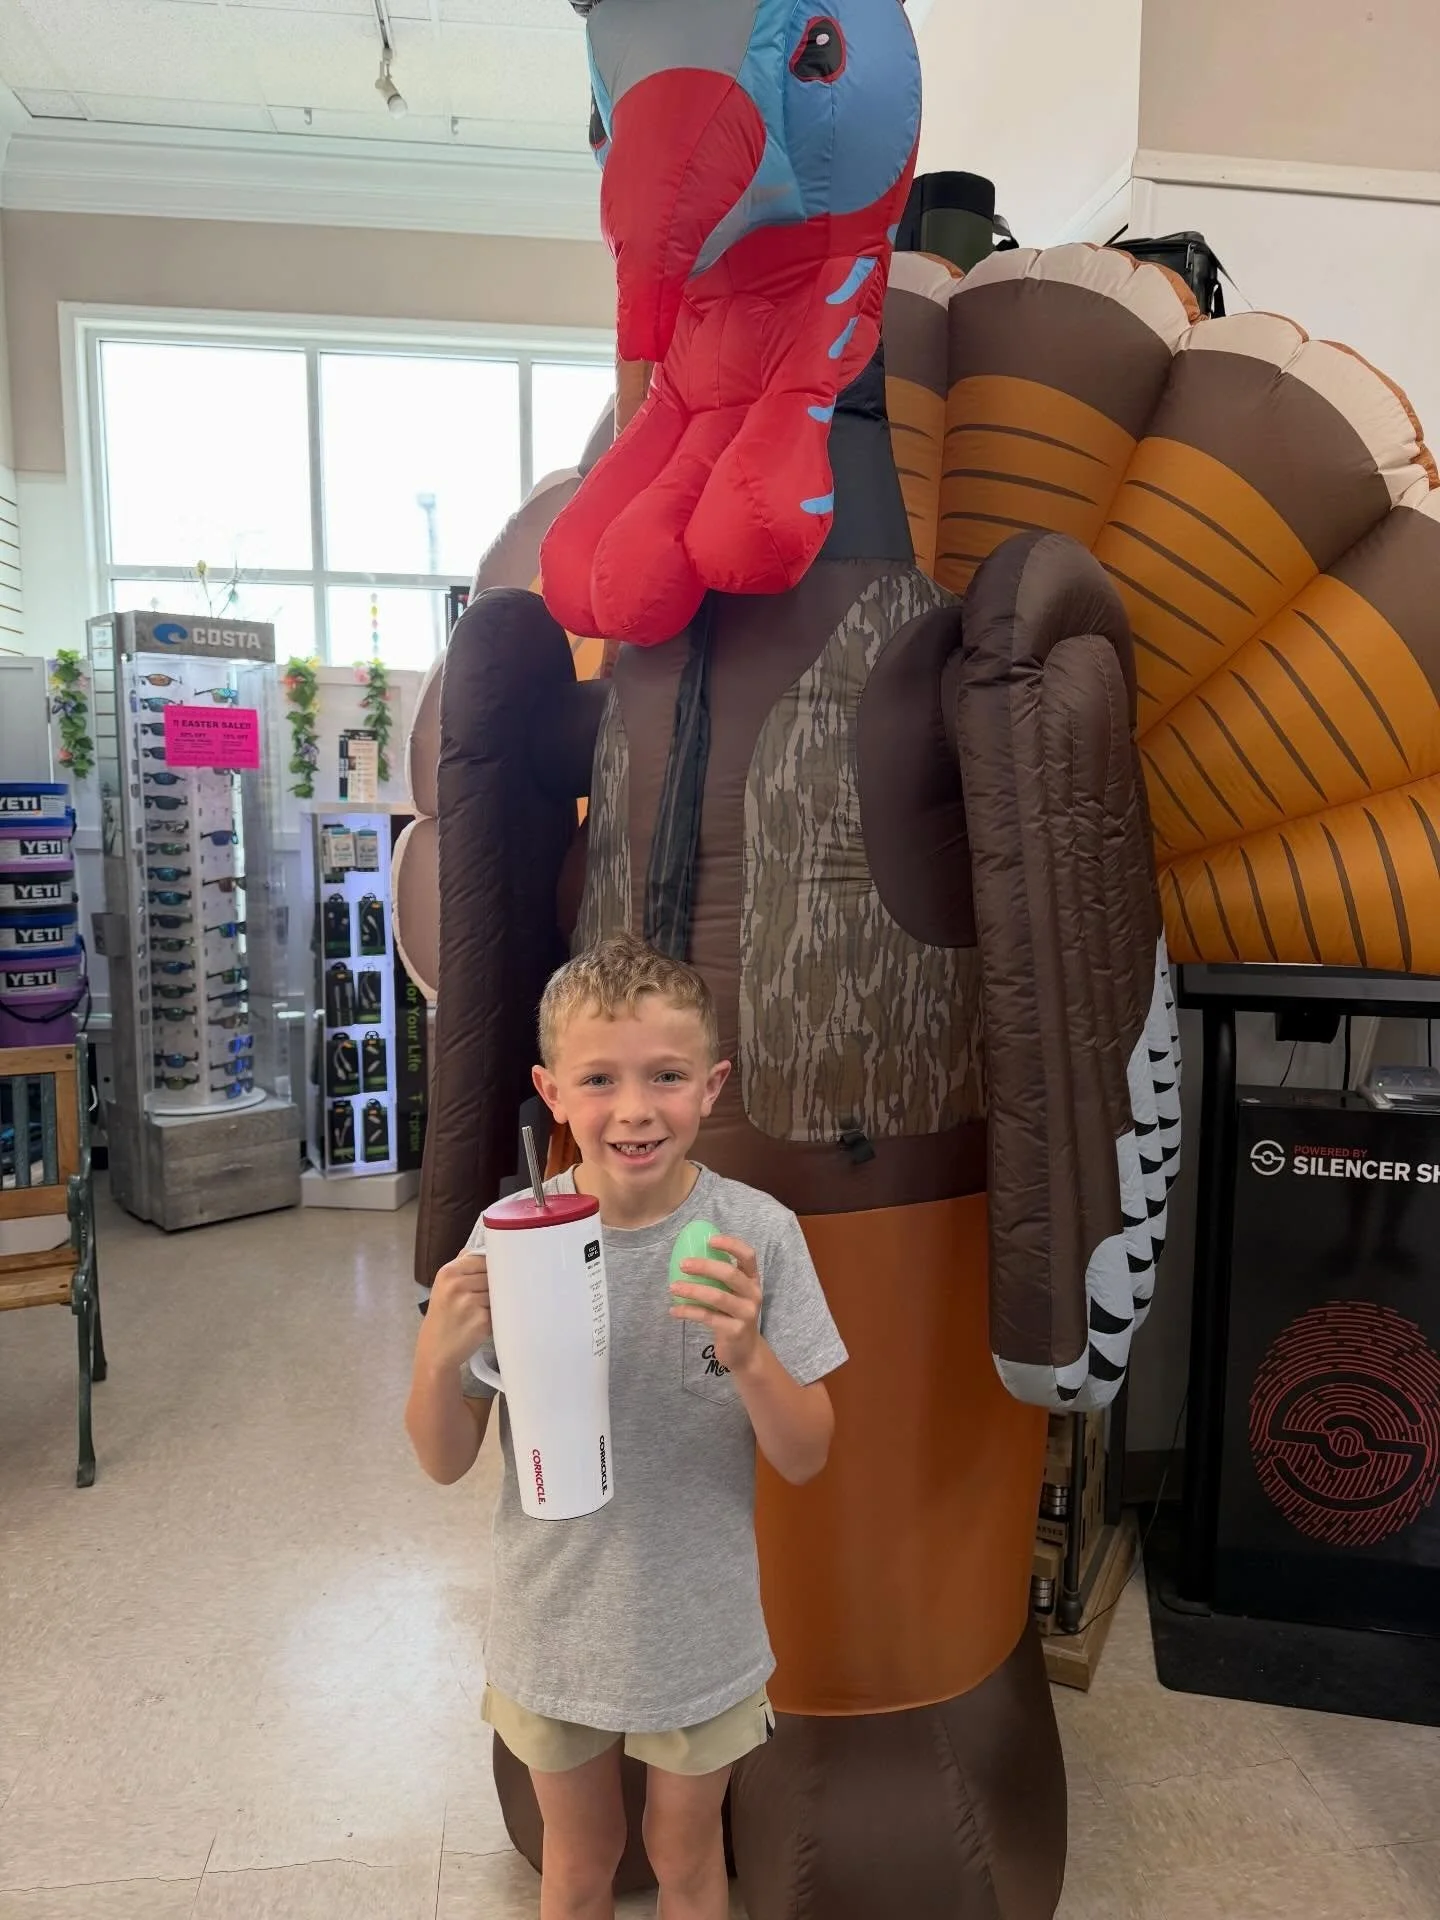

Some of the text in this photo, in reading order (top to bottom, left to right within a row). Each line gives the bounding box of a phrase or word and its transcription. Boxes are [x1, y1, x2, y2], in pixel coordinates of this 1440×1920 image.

[192, 627, 261, 649] COSTA
[181, 719, 219, 729] EASTER
[0, 796, 38, 811] YETI
[23, 840, 62, 854] YETI
[17, 884, 60, 899] YETI
[18, 928, 61, 943] YETI
[9, 972, 53, 987] YETI
[406, 1007, 421, 1041] Your
[407, 1044, 422, 1072] Life
[1293, 1145, 1368, 1158] POWERED BY
[1293, 1156, 1411, 1182] SILENCER
